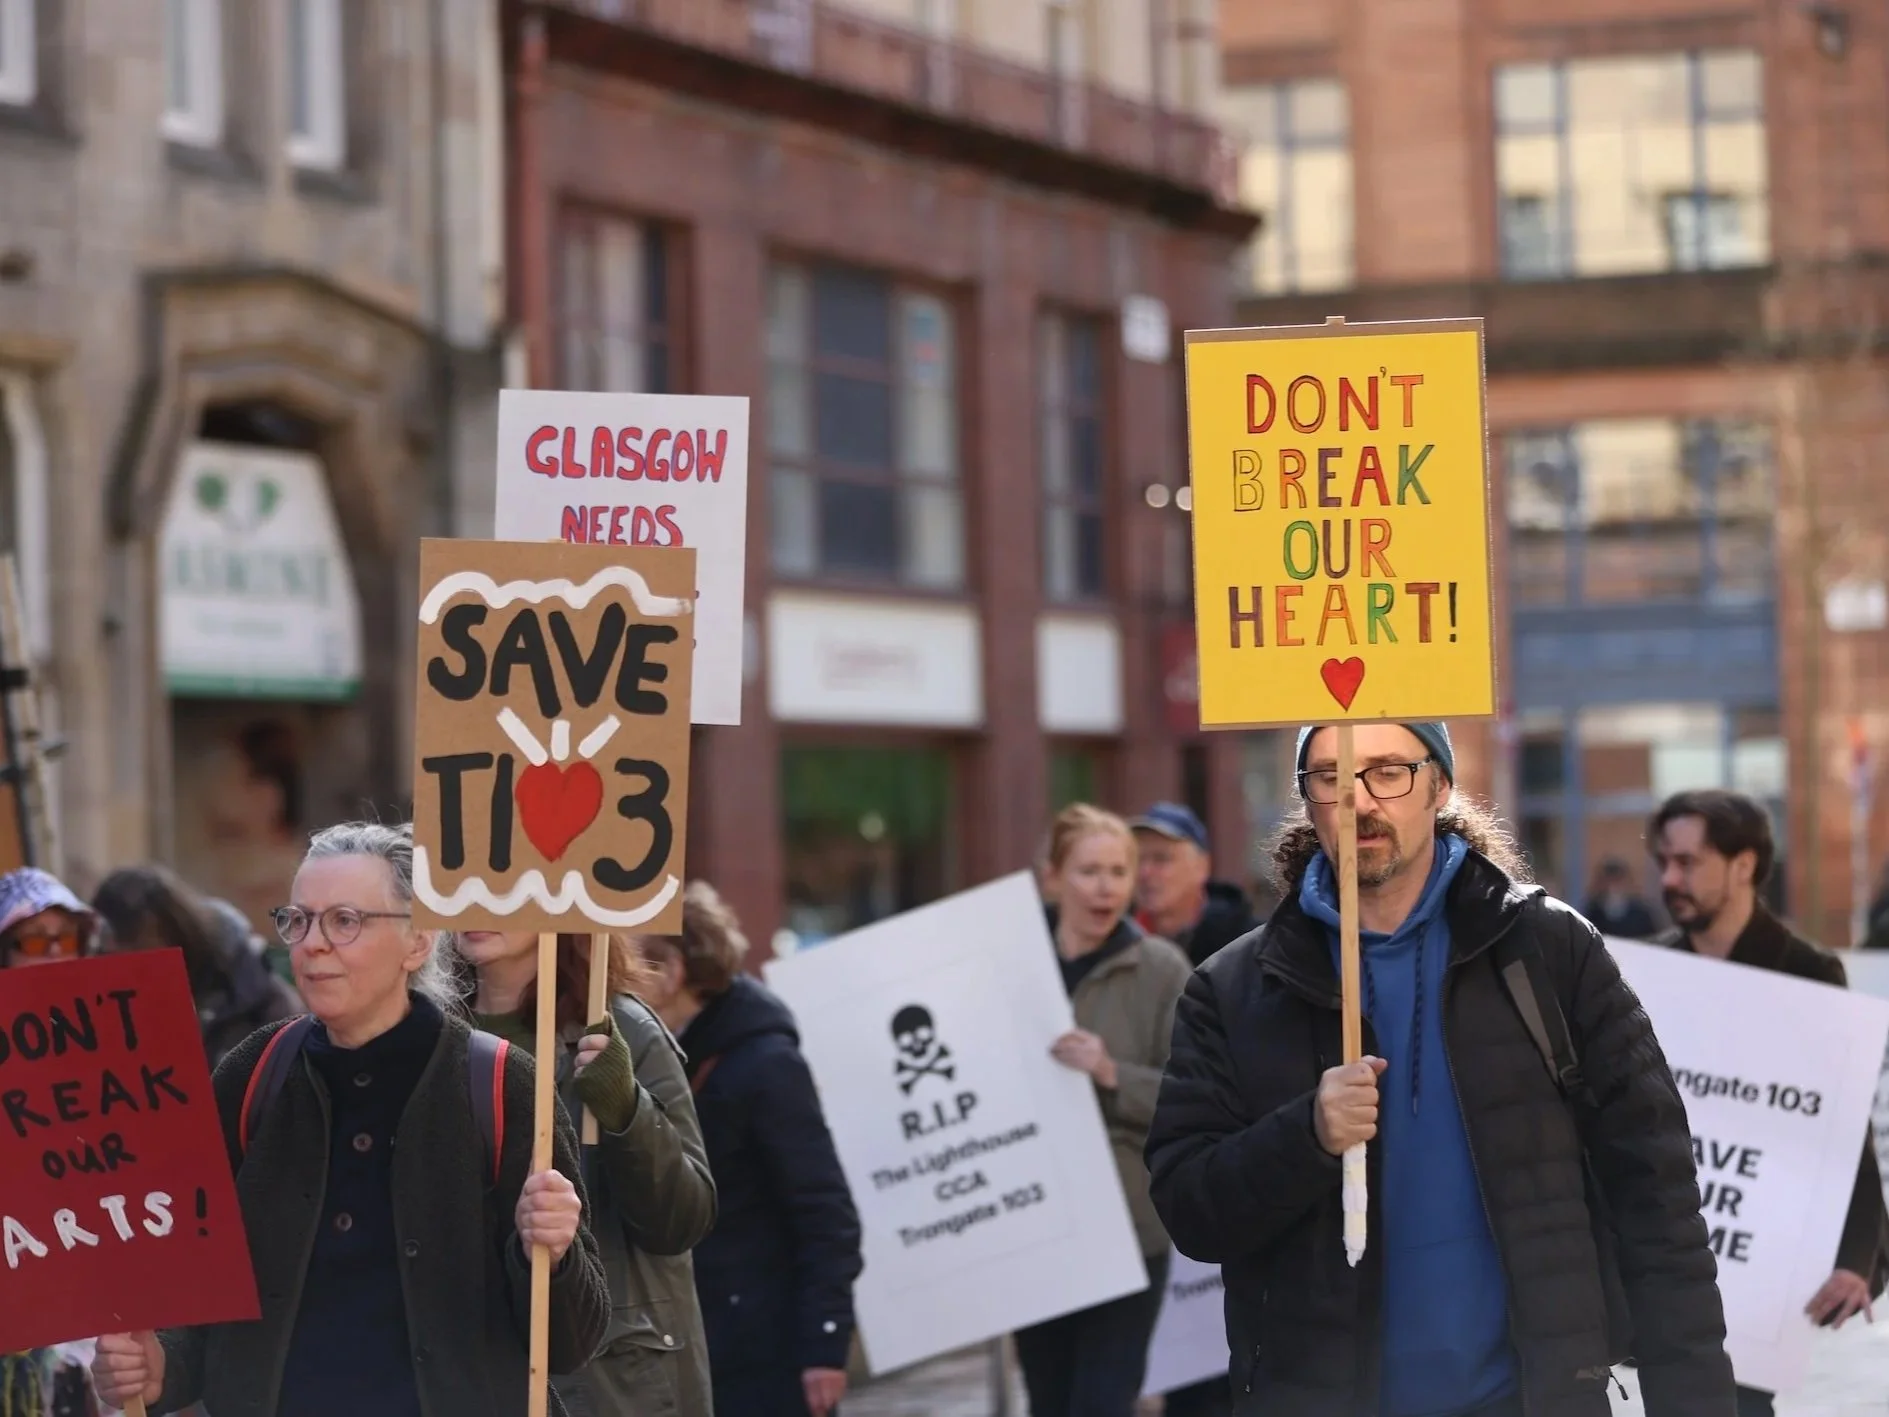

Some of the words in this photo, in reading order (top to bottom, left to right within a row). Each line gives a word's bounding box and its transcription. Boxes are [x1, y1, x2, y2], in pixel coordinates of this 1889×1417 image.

[1246, 366, 1424, 434] DON'T
[525, 425, 728, 483] GLASGOW
[1233, 444, 1435, 512] BREAK
[561, 505, 684, 547] NEEDS
[1283, 518, 1397, 580] OUR
[1228, 581, 1458, 648] HEART!
[427, 603, 679, 719] SAVE
[1, 1064, 188, 1137] REAK
[1668, 1066, 1760, 1104] ngate
[1765, 1081, 1822, 1117] 103
[42, 1132, 137, 1180] OUR
[872, 1167, 910, 1190] The
[1690, 1135, 1763, 1180] AVE
[935, 1170, 989, 1202] CCA
[1001, 1182, 1046, 1212] 103
[1700, 1180, 1744, 1217] UR
